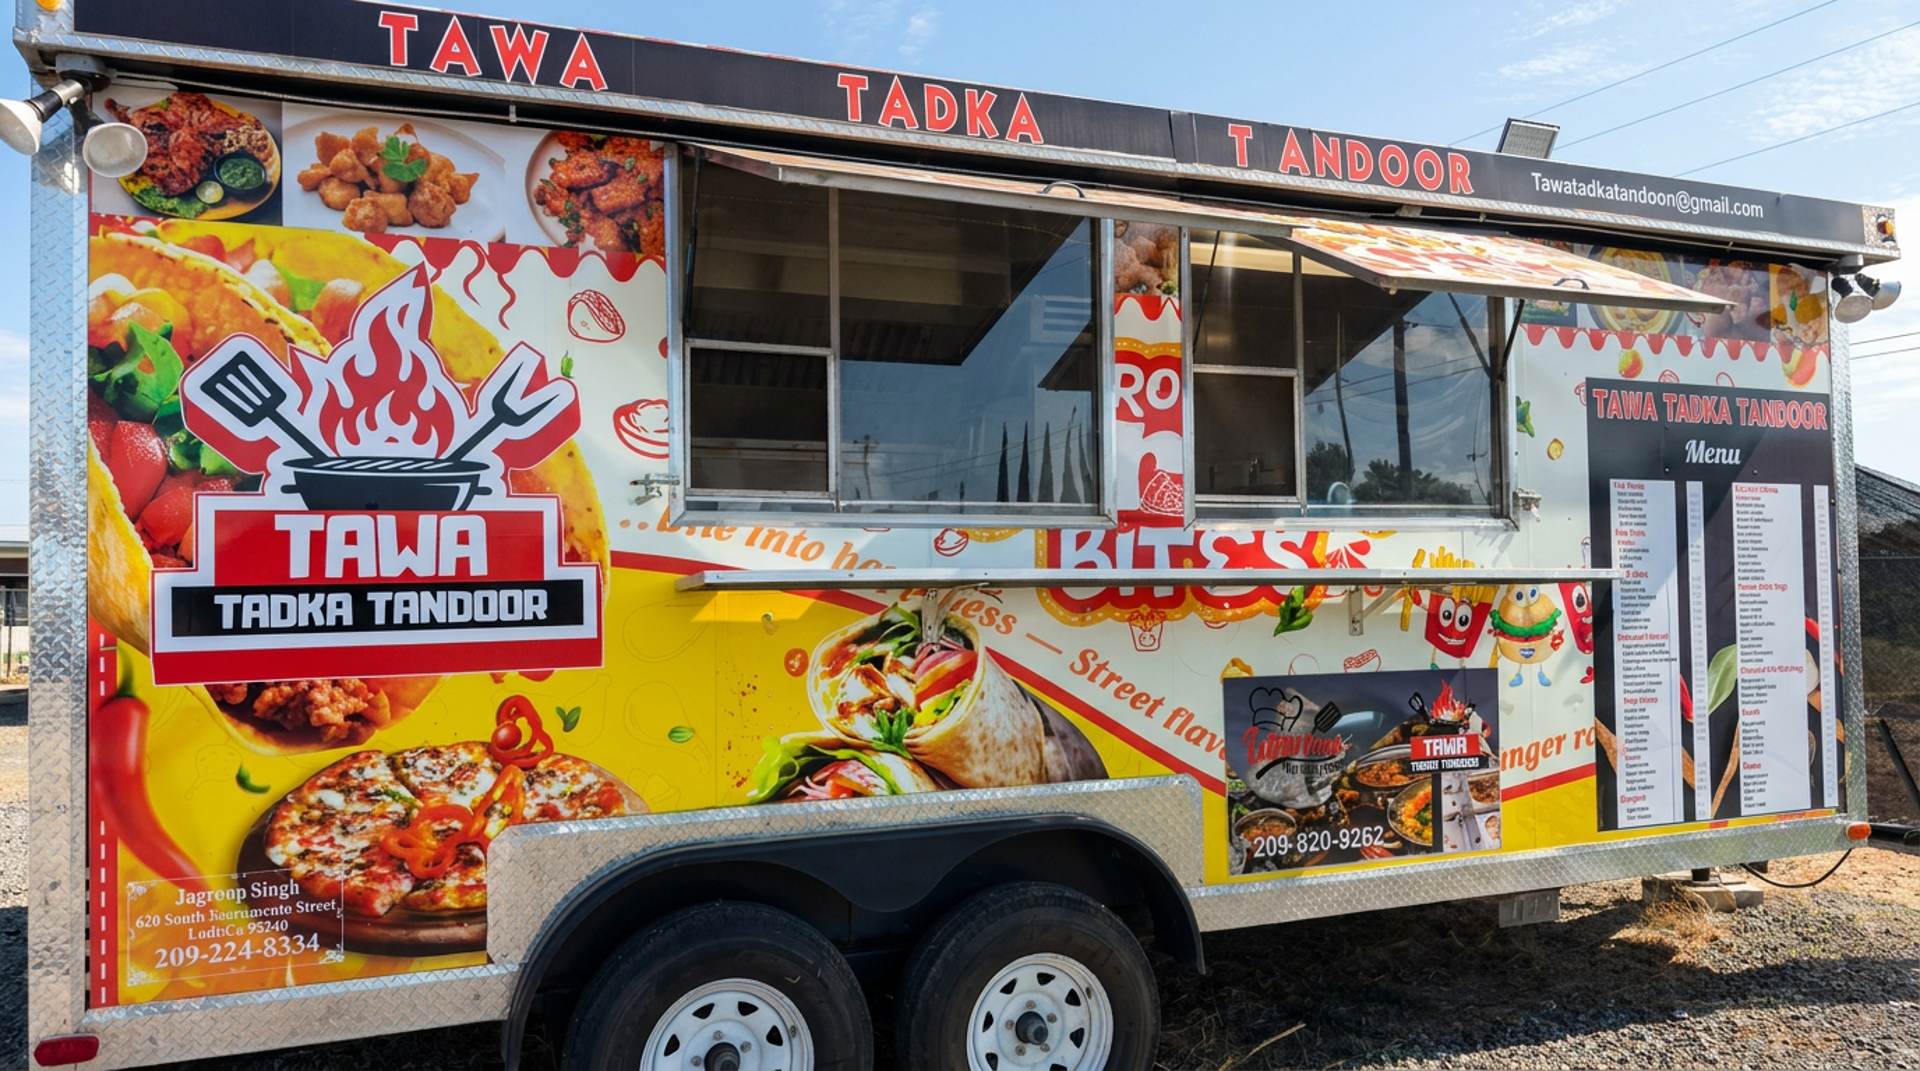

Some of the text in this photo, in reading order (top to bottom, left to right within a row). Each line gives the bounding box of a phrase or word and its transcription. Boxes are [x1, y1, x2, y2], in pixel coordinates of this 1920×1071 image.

[378, 11, 608, 91] TAWA
[837, 73, 1044, 144] TADKA
[1531, 172, 1764, 219] Tawatadkatandoon@gmail.com
[1593, 388, 1828, 430] TAWA TADKA TANDOOR
[1685, 438, 1741, 465] Menu
[274, 513, 488, 579] TAWA
[744, 526, 825, 562] into
[214, 589, 548, 629] TADKA TANDOOR
[1068, 648, 1166, 719] Street
[1423, 736, 1468, 757] TAWA
[250, 878, 300, 901] Singh
[136, 914, 161, 928] 620
[164, 907, 205, 926] South
[296, 900, 337, 912] Street
[155, 932, 319, 969] 209-224-8334
